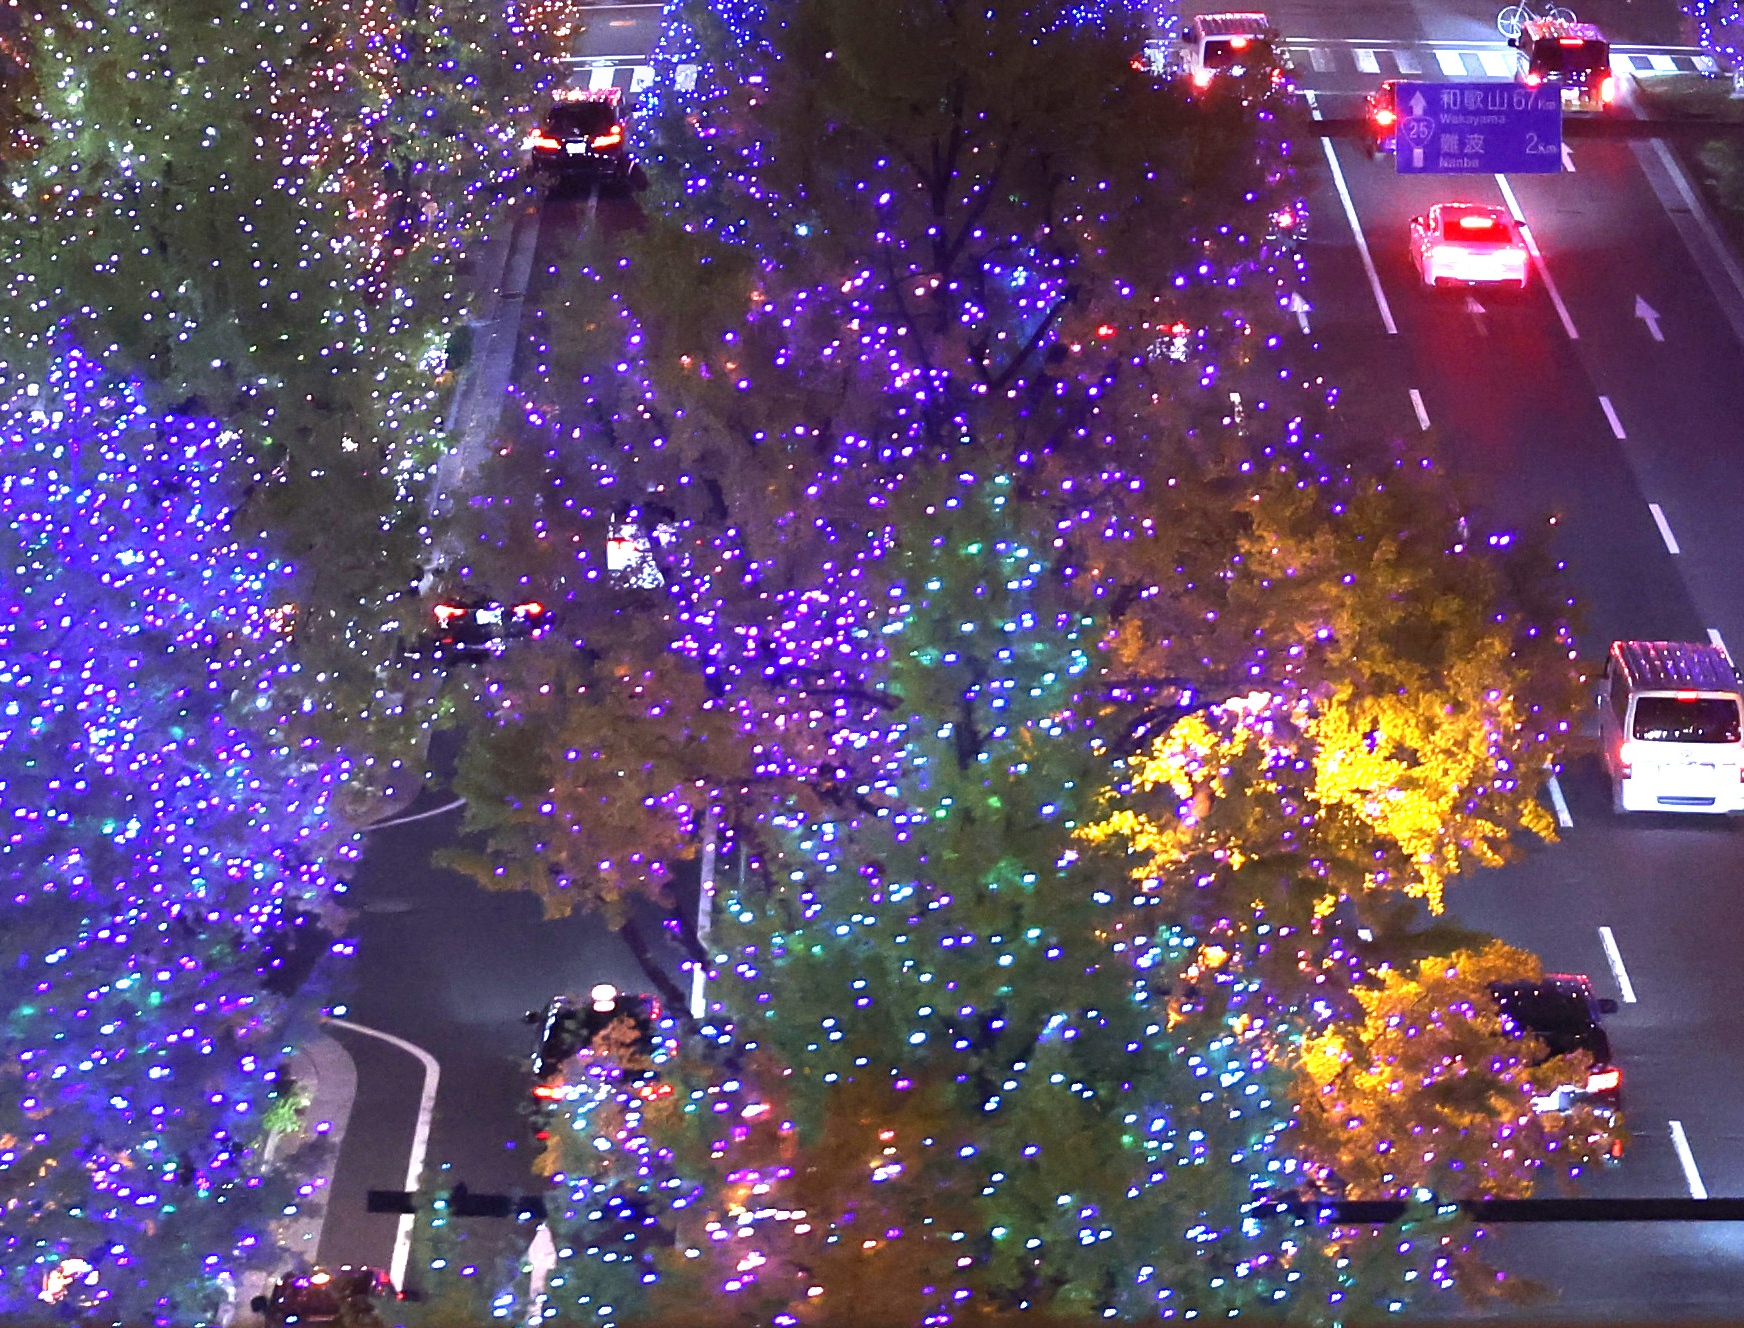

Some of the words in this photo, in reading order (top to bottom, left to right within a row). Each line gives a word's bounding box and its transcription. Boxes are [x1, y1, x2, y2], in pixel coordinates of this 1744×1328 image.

[1439, 88, 1508, 111] 和歌山
[1439, 113, 1507, 126] Wakayama
[1409, 121, 1429, 139] 25
[1439, 133, 1486, 155] 難波
[1439, 158, 1479, 168] Nanba
